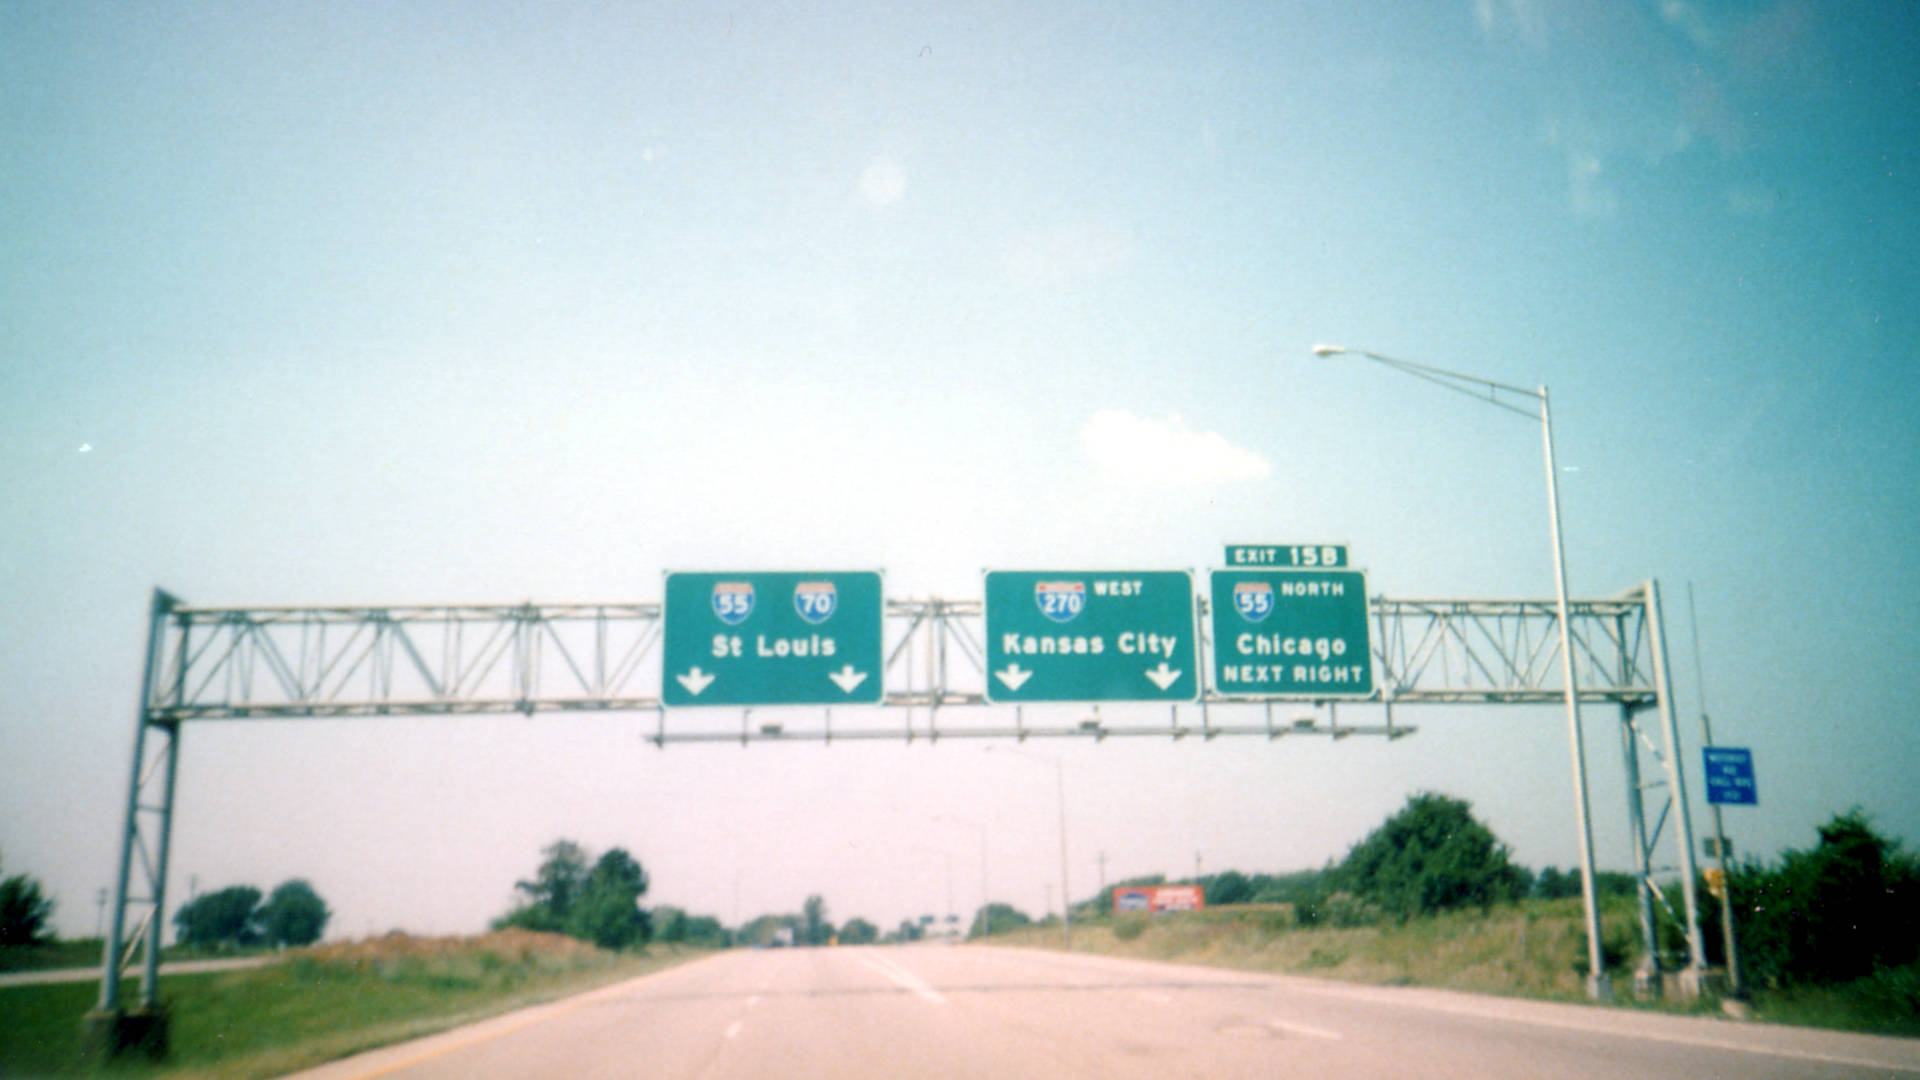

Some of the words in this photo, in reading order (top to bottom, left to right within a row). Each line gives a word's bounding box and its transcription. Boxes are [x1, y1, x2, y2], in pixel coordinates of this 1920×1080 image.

[1234, 549, 1276, 563] EXIT
[1290, 547, 1338, 566] 15B
[718, 594, 750, 614] 55
[801, 594, 830, 614] 70
[1044, 594, 1081, 614] 270
[1093, 581, 1143, 596] WEST
[1239, 594, 1269, 613] 55
[1281, 582, 1344, 596] NORTH
[711, 634, 743, 658] St
[756, 634, 836, 657] Louis
[1002, 633, 1105, 654] Kansas
[1117, 632, 1177, 659] City
[1236, 633, 1347, 661] Chicago
[1223, 665, 1284, 682] NEXT
[1293, 666, 1363, 683] RIGHT
